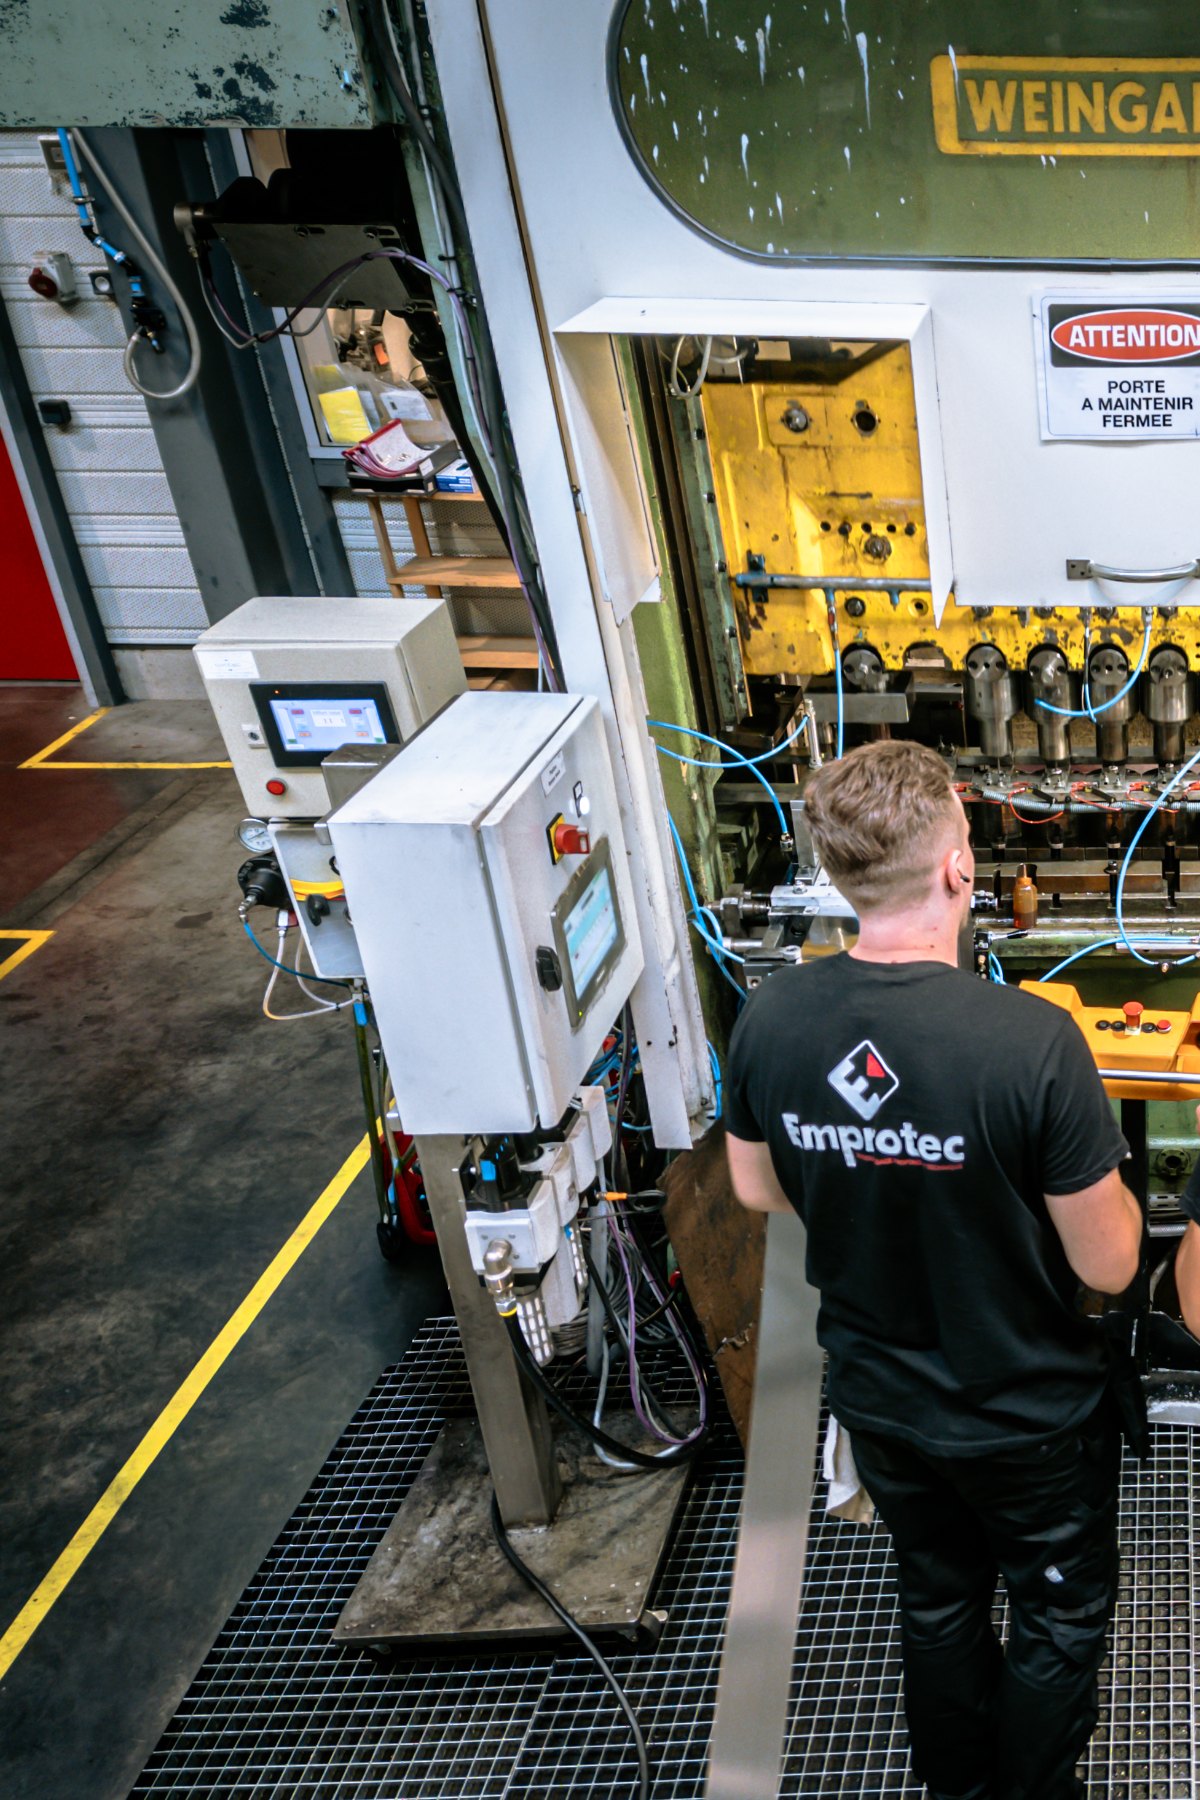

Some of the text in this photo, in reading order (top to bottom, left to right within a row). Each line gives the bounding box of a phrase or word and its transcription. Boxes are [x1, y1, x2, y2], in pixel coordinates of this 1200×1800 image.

[1107, 380, 1165, 394] PORTE
[1081, 397, 1193, 411] A MAINTENIR
[1102, 413, 1173, 428] FERMEE
[781, 1112, 965, 1168] Emprotec
